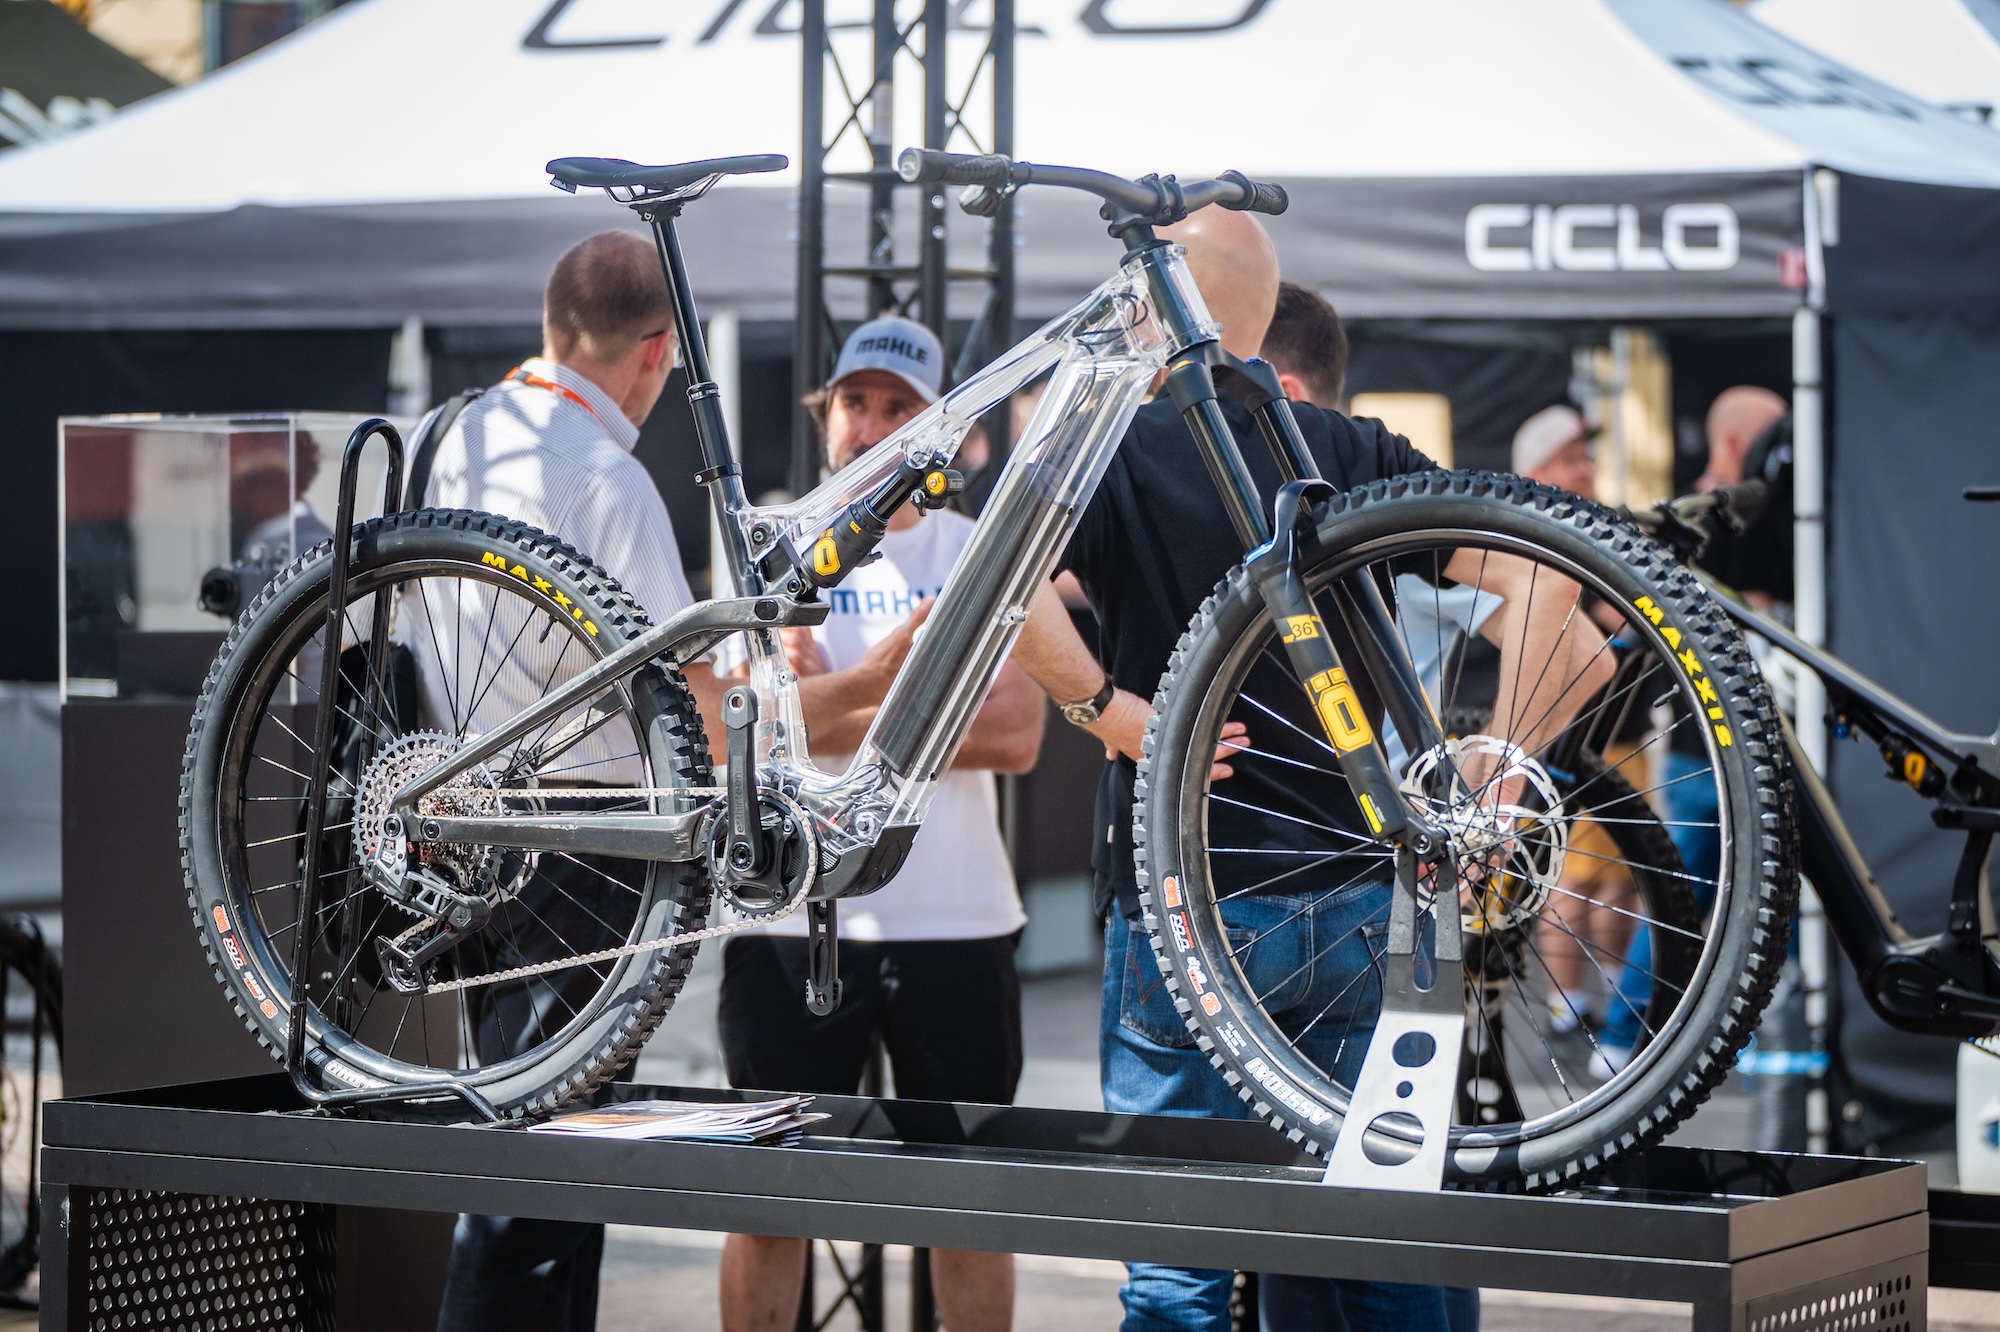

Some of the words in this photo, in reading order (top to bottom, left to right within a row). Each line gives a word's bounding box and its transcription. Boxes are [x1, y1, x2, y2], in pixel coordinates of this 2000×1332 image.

[1464, 203, 1740, 271] CICLO
[855, 336, 928, 365] MAHLE
[481, 551, 599, 637] MAXXIS
[830, 587, 943, 614] MAH
[1292, 622, 1313, 637] 36
[1633, 595, 1734, 747] MAXXIS
[1169, 913, 1191, 953] TR
[223, 937, 243, 970] TR
[1245, 1057, 1332, 1125] ASSEGAI
